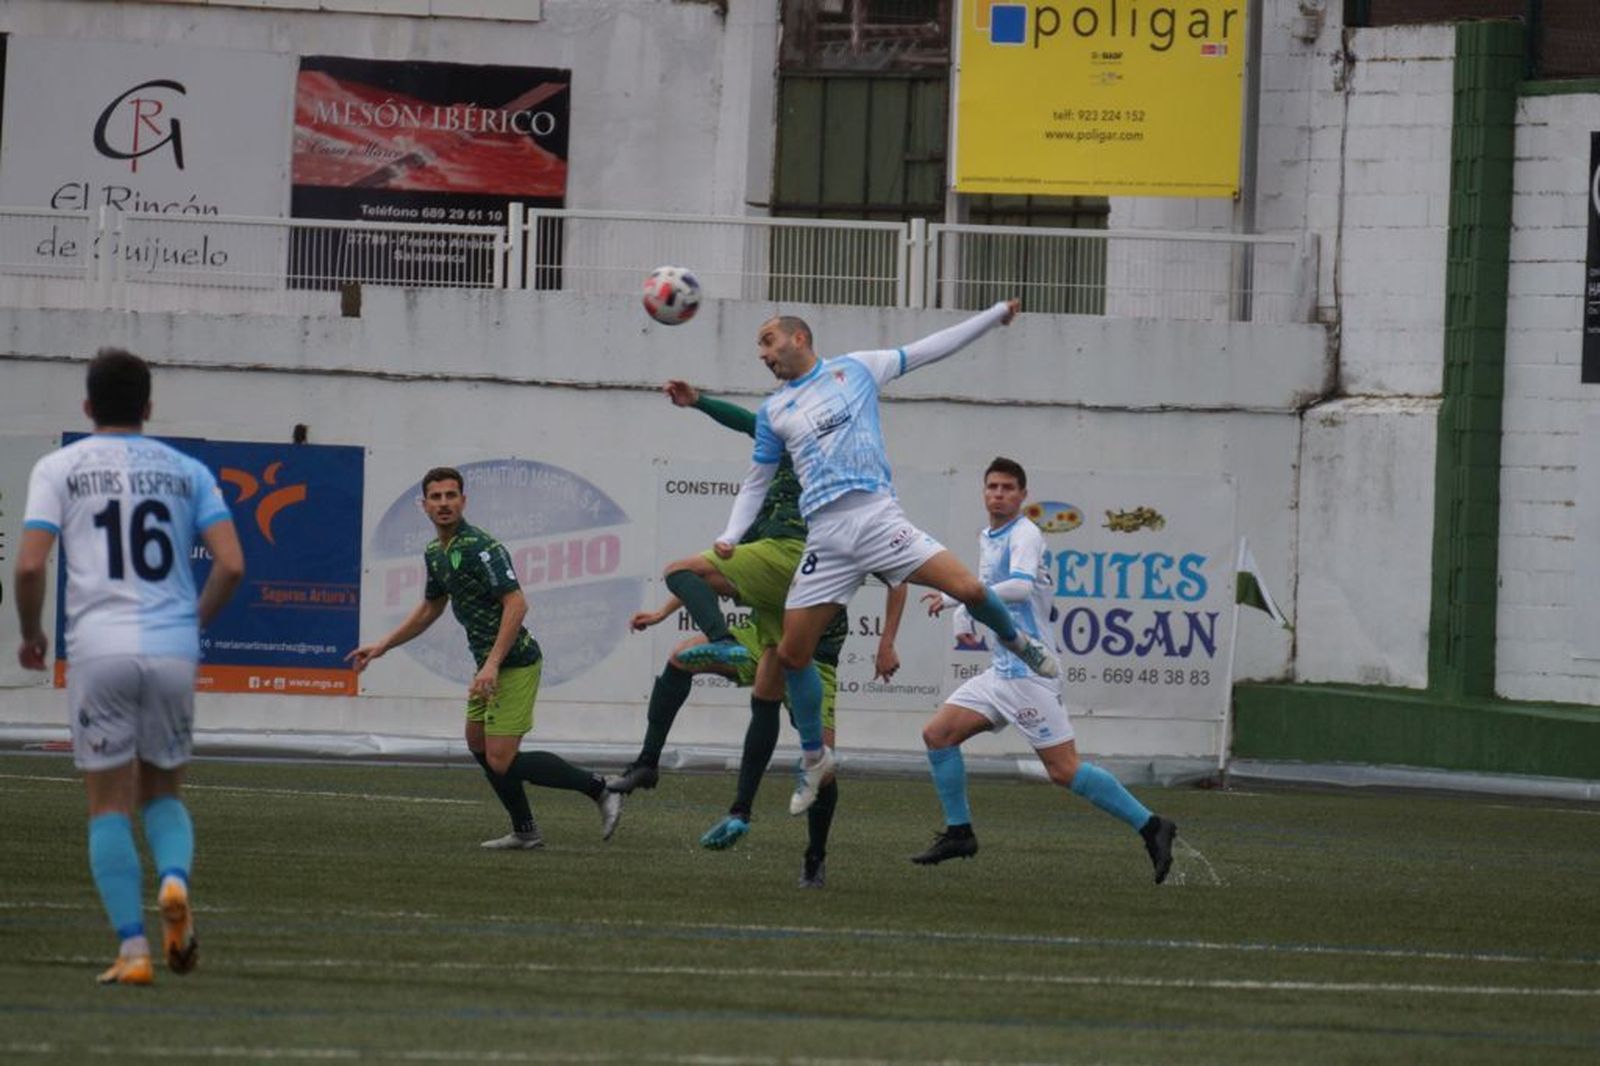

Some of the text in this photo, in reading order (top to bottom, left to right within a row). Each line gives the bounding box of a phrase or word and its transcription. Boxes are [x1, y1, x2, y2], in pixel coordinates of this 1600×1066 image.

[1033, 0, 1238, 51] poligar
[313, 99, 556, 136] MESÓN IBÉRICO
[1078, 111, 1098, 122] 923
[1101, 111, 1121, 122] 224
[1126, 111, 1145, 122] 152
[1045, 128, 1144, 144] www.poligar.com
[50, 182, 219, 216] El Rincón
[360, 204, 503, 221] Teléfono 689 29 61 10
[36, 225, 77, 258] de
[94, 499, 174, 583] 16
[801, 552, 818, 575] 8
[1102, 668, 1134, 684] 669
[1138, 669, 1159, 685] 48
[1164, 670, 1185, 685] 38
[1190, 670, 1210, 686] 83
